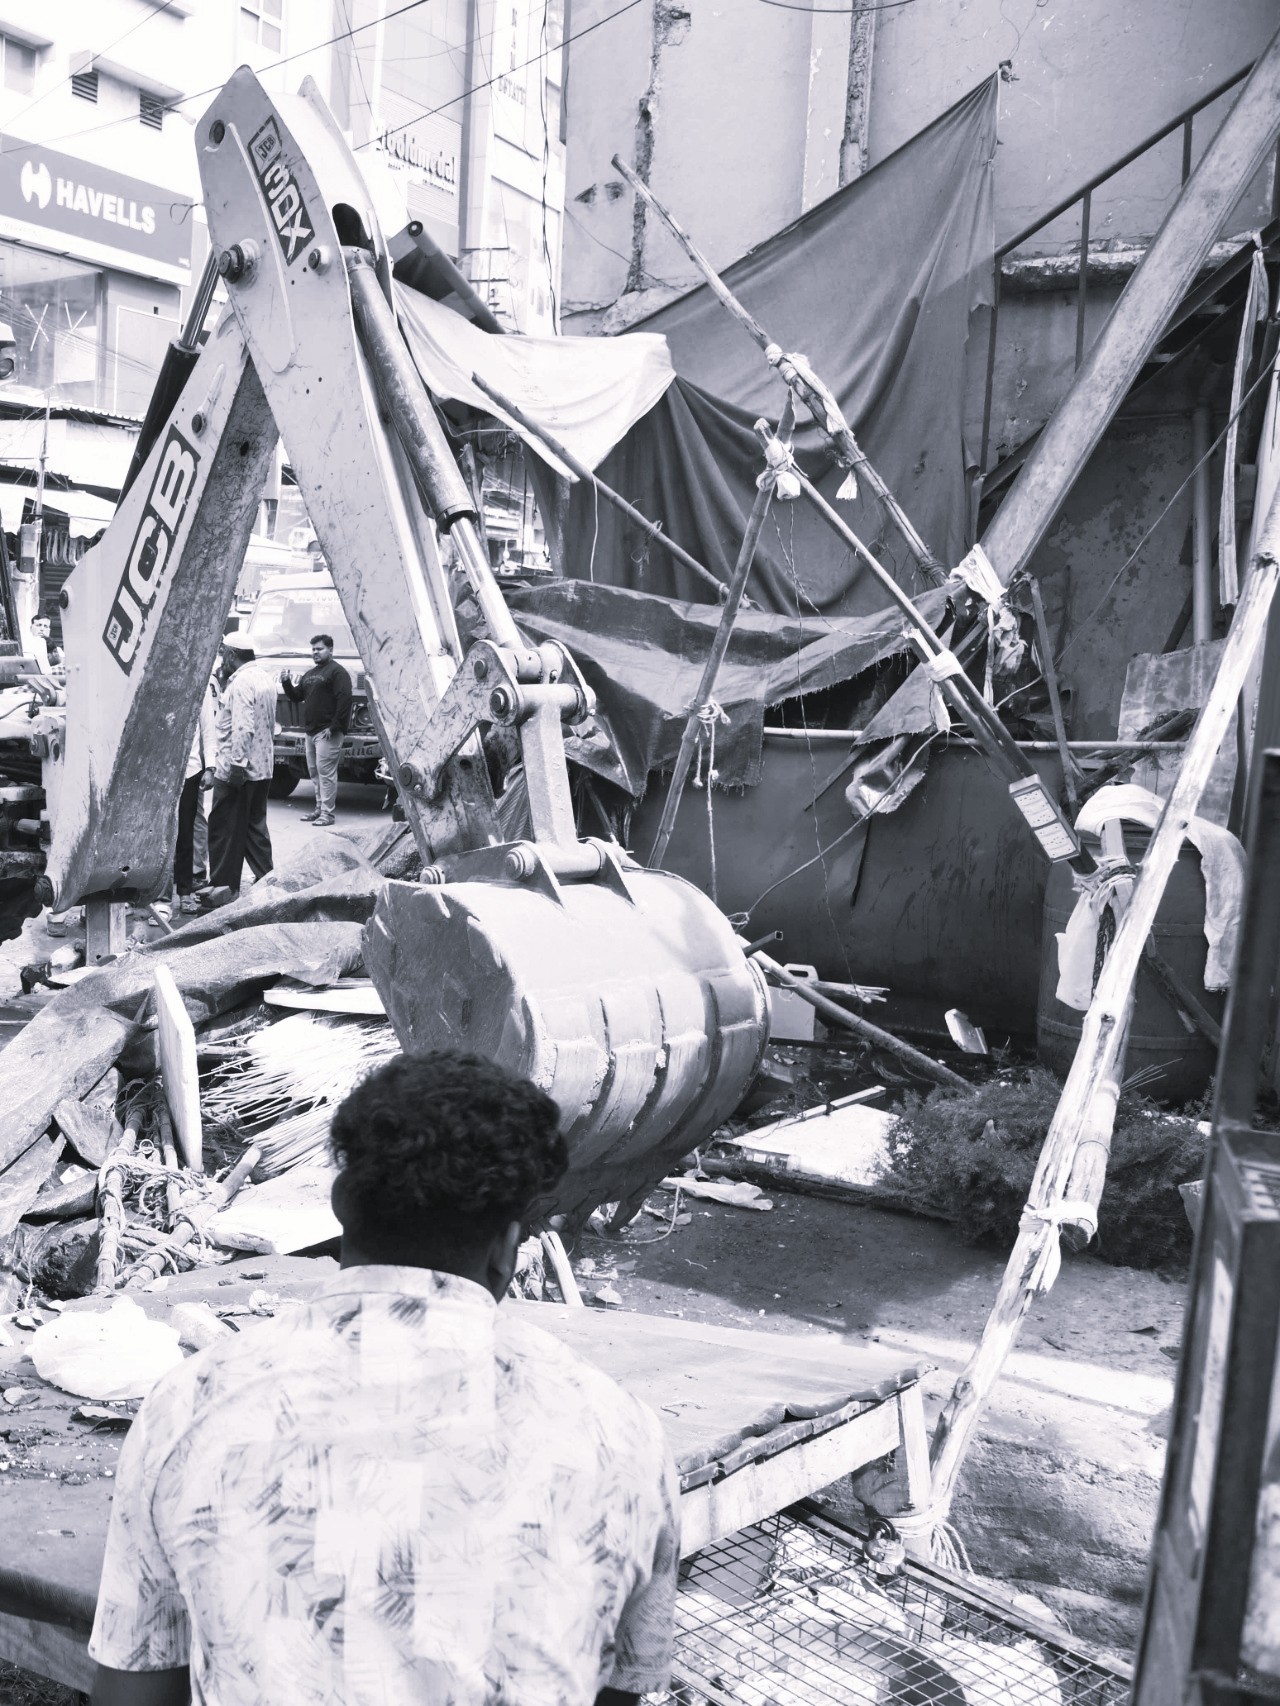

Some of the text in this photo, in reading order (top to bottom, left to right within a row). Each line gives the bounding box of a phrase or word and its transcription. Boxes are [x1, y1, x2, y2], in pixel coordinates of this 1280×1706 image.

[257, 134, 276, 159] JCB
[55, 176, 156, 235] HAVELLS
[264, 163, 313, 260] 3DX
[118, 438, 196, 664] JCB
